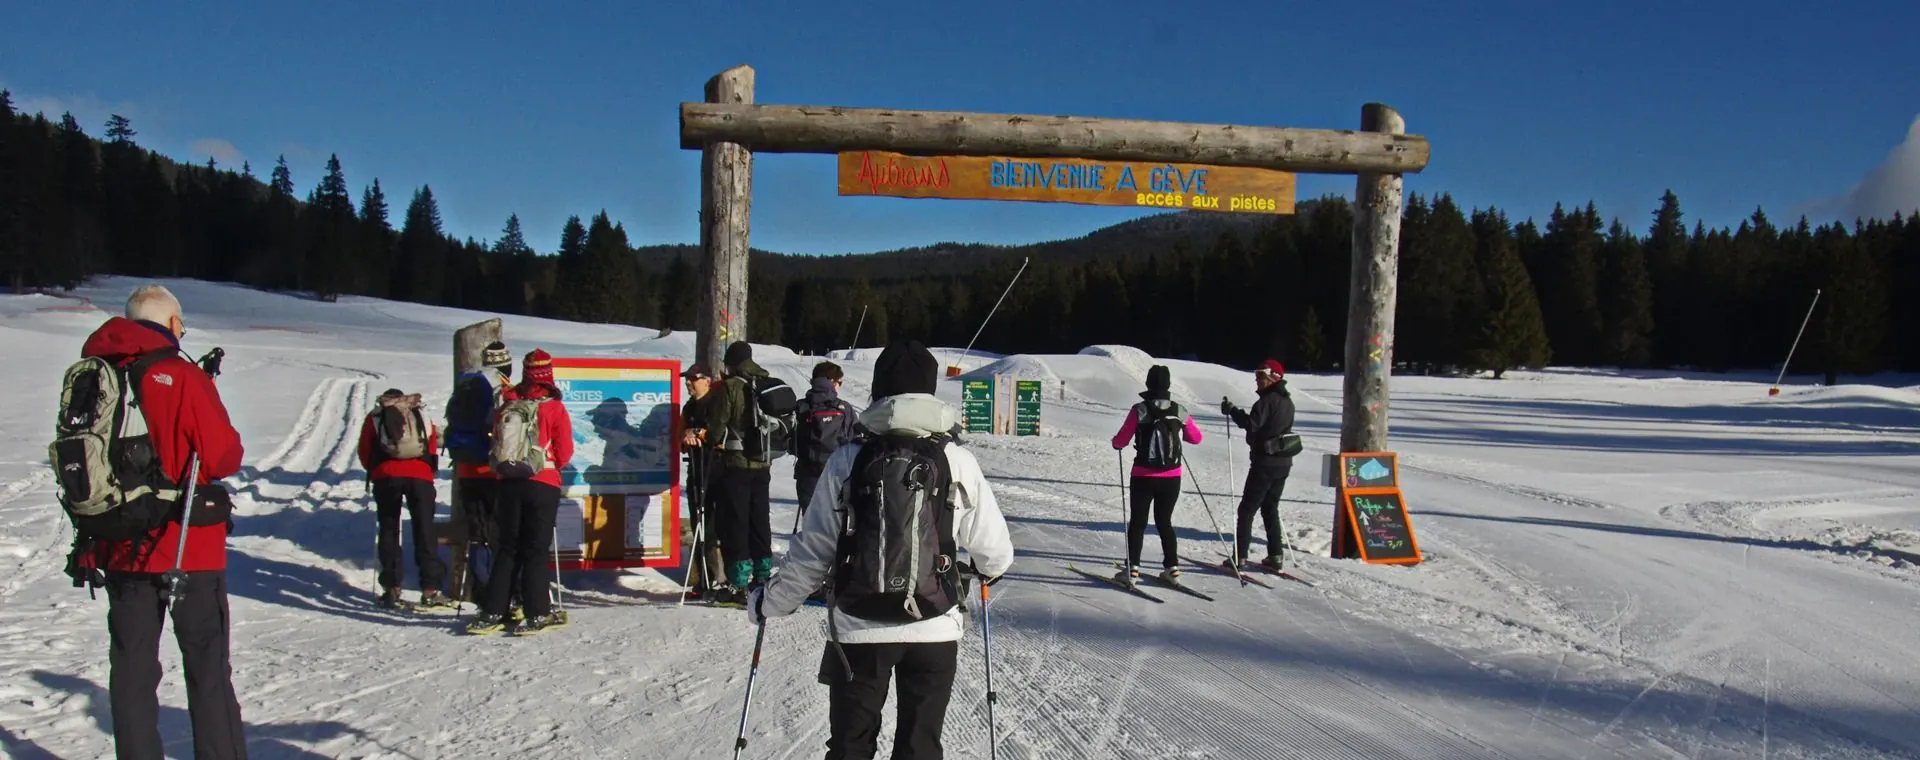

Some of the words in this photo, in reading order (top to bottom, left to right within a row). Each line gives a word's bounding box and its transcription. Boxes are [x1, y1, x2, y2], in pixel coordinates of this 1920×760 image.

[991, 160, 1105, 190] BIENVENUE
[1150, 164, 1208, 195] GÈVE
[1192, 195, 1219, 208] aux
[1230, 193, 1276, 211] pistes
